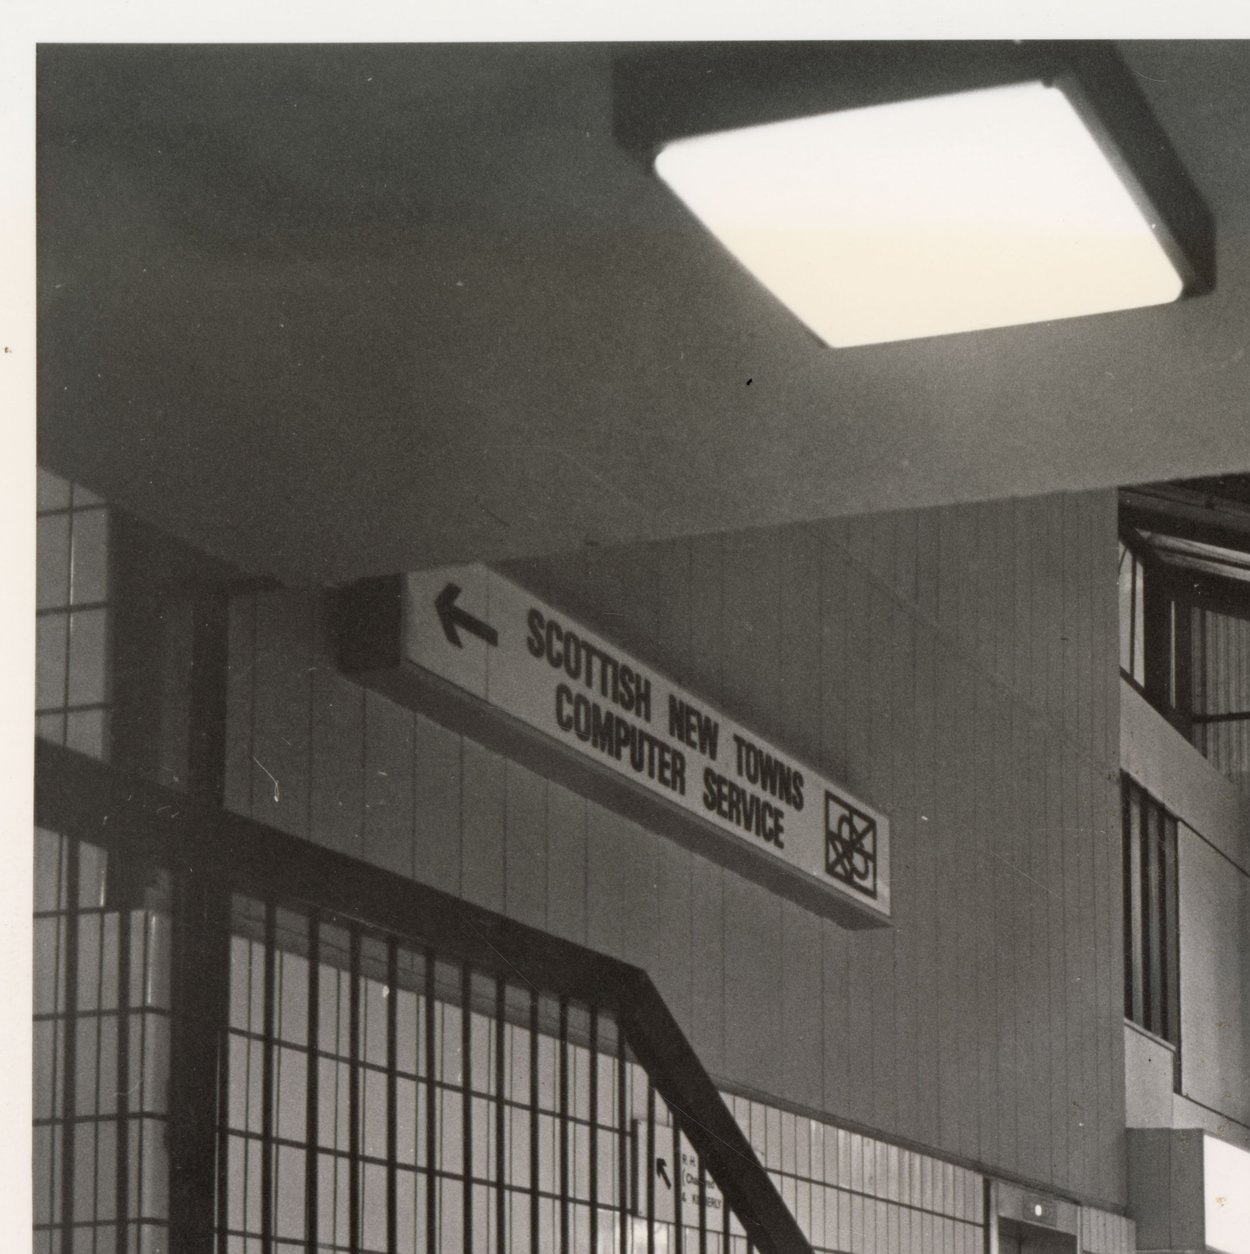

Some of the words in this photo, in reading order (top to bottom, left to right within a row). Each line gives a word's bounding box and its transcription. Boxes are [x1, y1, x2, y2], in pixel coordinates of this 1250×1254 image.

[527, 607, 651, 723] SCOTTISH
[669, 694, 719, 761] NEW
[733, 733, 804, 812] TOWNS
[555, 684, 686, 796] COMPUTER
[703, 767, 785, 850] SERVICE
